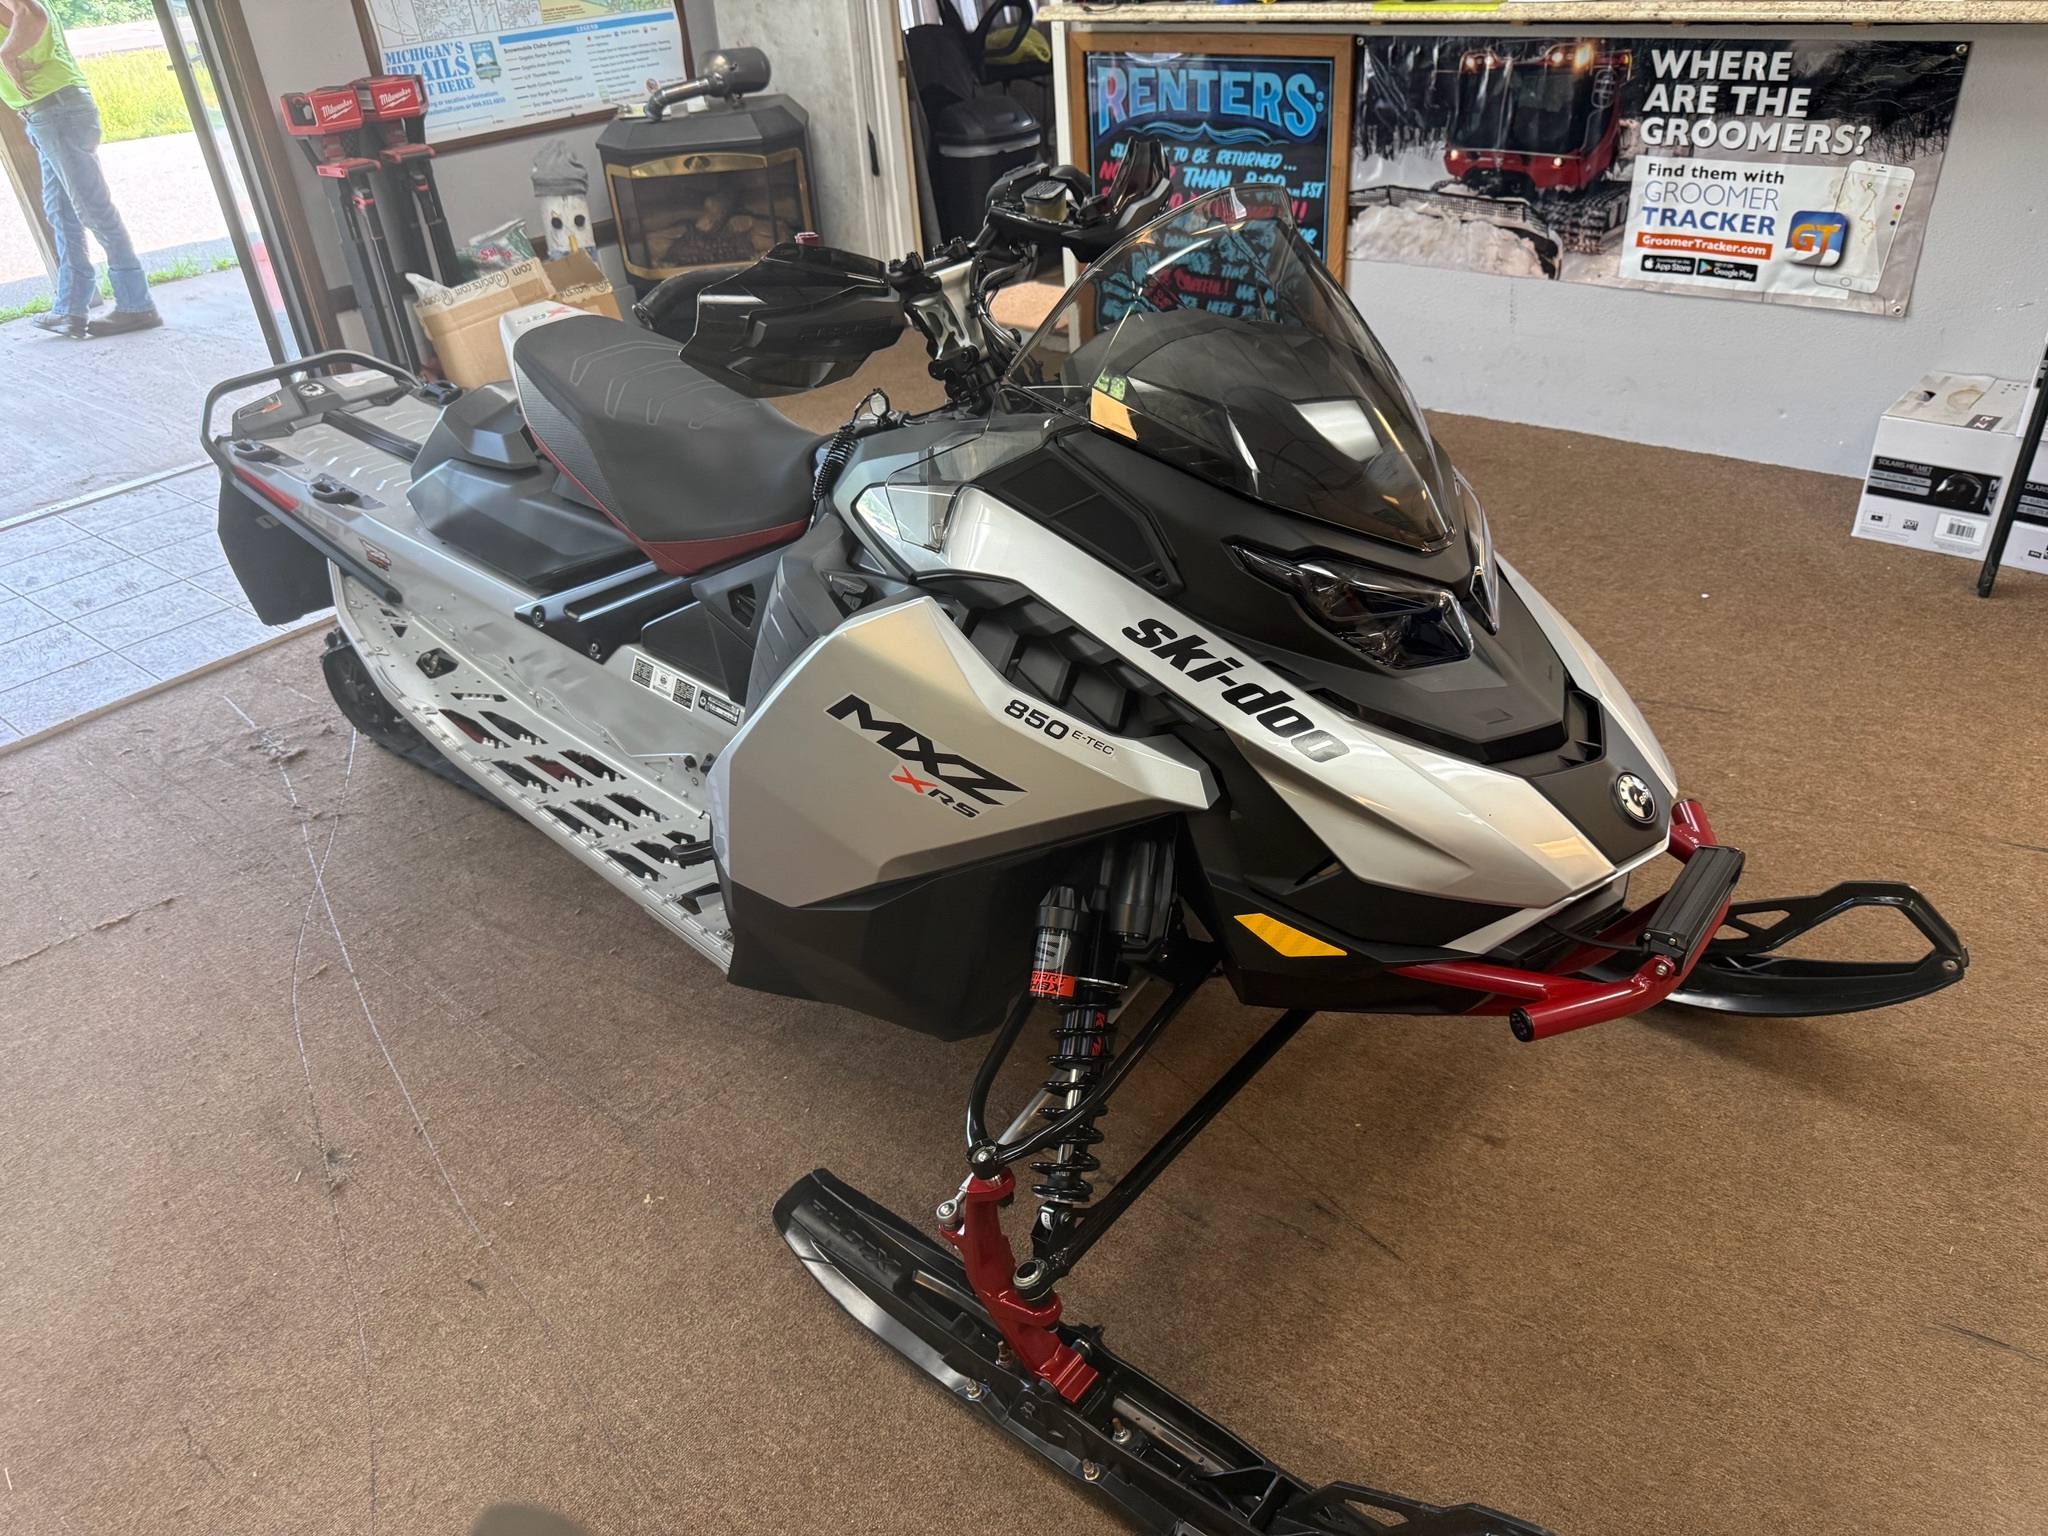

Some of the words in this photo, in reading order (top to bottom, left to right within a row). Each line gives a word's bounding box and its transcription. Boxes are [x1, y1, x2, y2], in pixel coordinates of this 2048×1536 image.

[576, 24, 599, 32] LEGEND
[384, 41, 465, 66] MICHIGAN'S
[503, 45, 532, 54] Snowmobile
[1650, 49, 1793, 82] WHERE
[436, 77, 476, 94] HERE
[378, 87, 411, 106] Milwaukee
[444, 96, 467, 104] vacation
[467, 91, 499, 100] information
[1096, 65, 1325, 138] RENTERS:
[1642, 84, 1719, 115] ARE
[1730, 86, 1812, 118] THE
[320, 98, 352, 118] Milwaukee
[1639, 118, 1873, 156] GROOMERS?
[1173, 146, 1189, 162] TO
[1192, 147, 1210, 164] BE
[1183, 167, 1232, 189] THAN
[1647, 163, 1685, 178] Find
[1691, 165, 1737, 181] them
[1743, 168, 1785, 184] with
[1301, 181, 1325, 198] EST
[1644, 180, 1779, 211] GROOMER
[1641, 206, 1775, 236] TRACKER
[1642, 235, 1767, 256] GroomerTracker.com
[1790, 222, 1842, 252] GT
[1655, 263, 1669, 272] App
[1672, 264, 1692, 272] Store
[1713, 266, 1738, 278] Google
[1739, 269, 1754, 281] Play
[1877, 457, 1905, 469] SOLARIS
[1906, 462, 1933, 473] HELMET
[2024, 482, 2048, 494] OLARIS
[1121, 618, 1351, 764] ski-doo
[1004, 698, 1070, 741] 850
[1071, 729, 1115, 756] E-TEC
[824, 693, 1030, 807] MXZ
